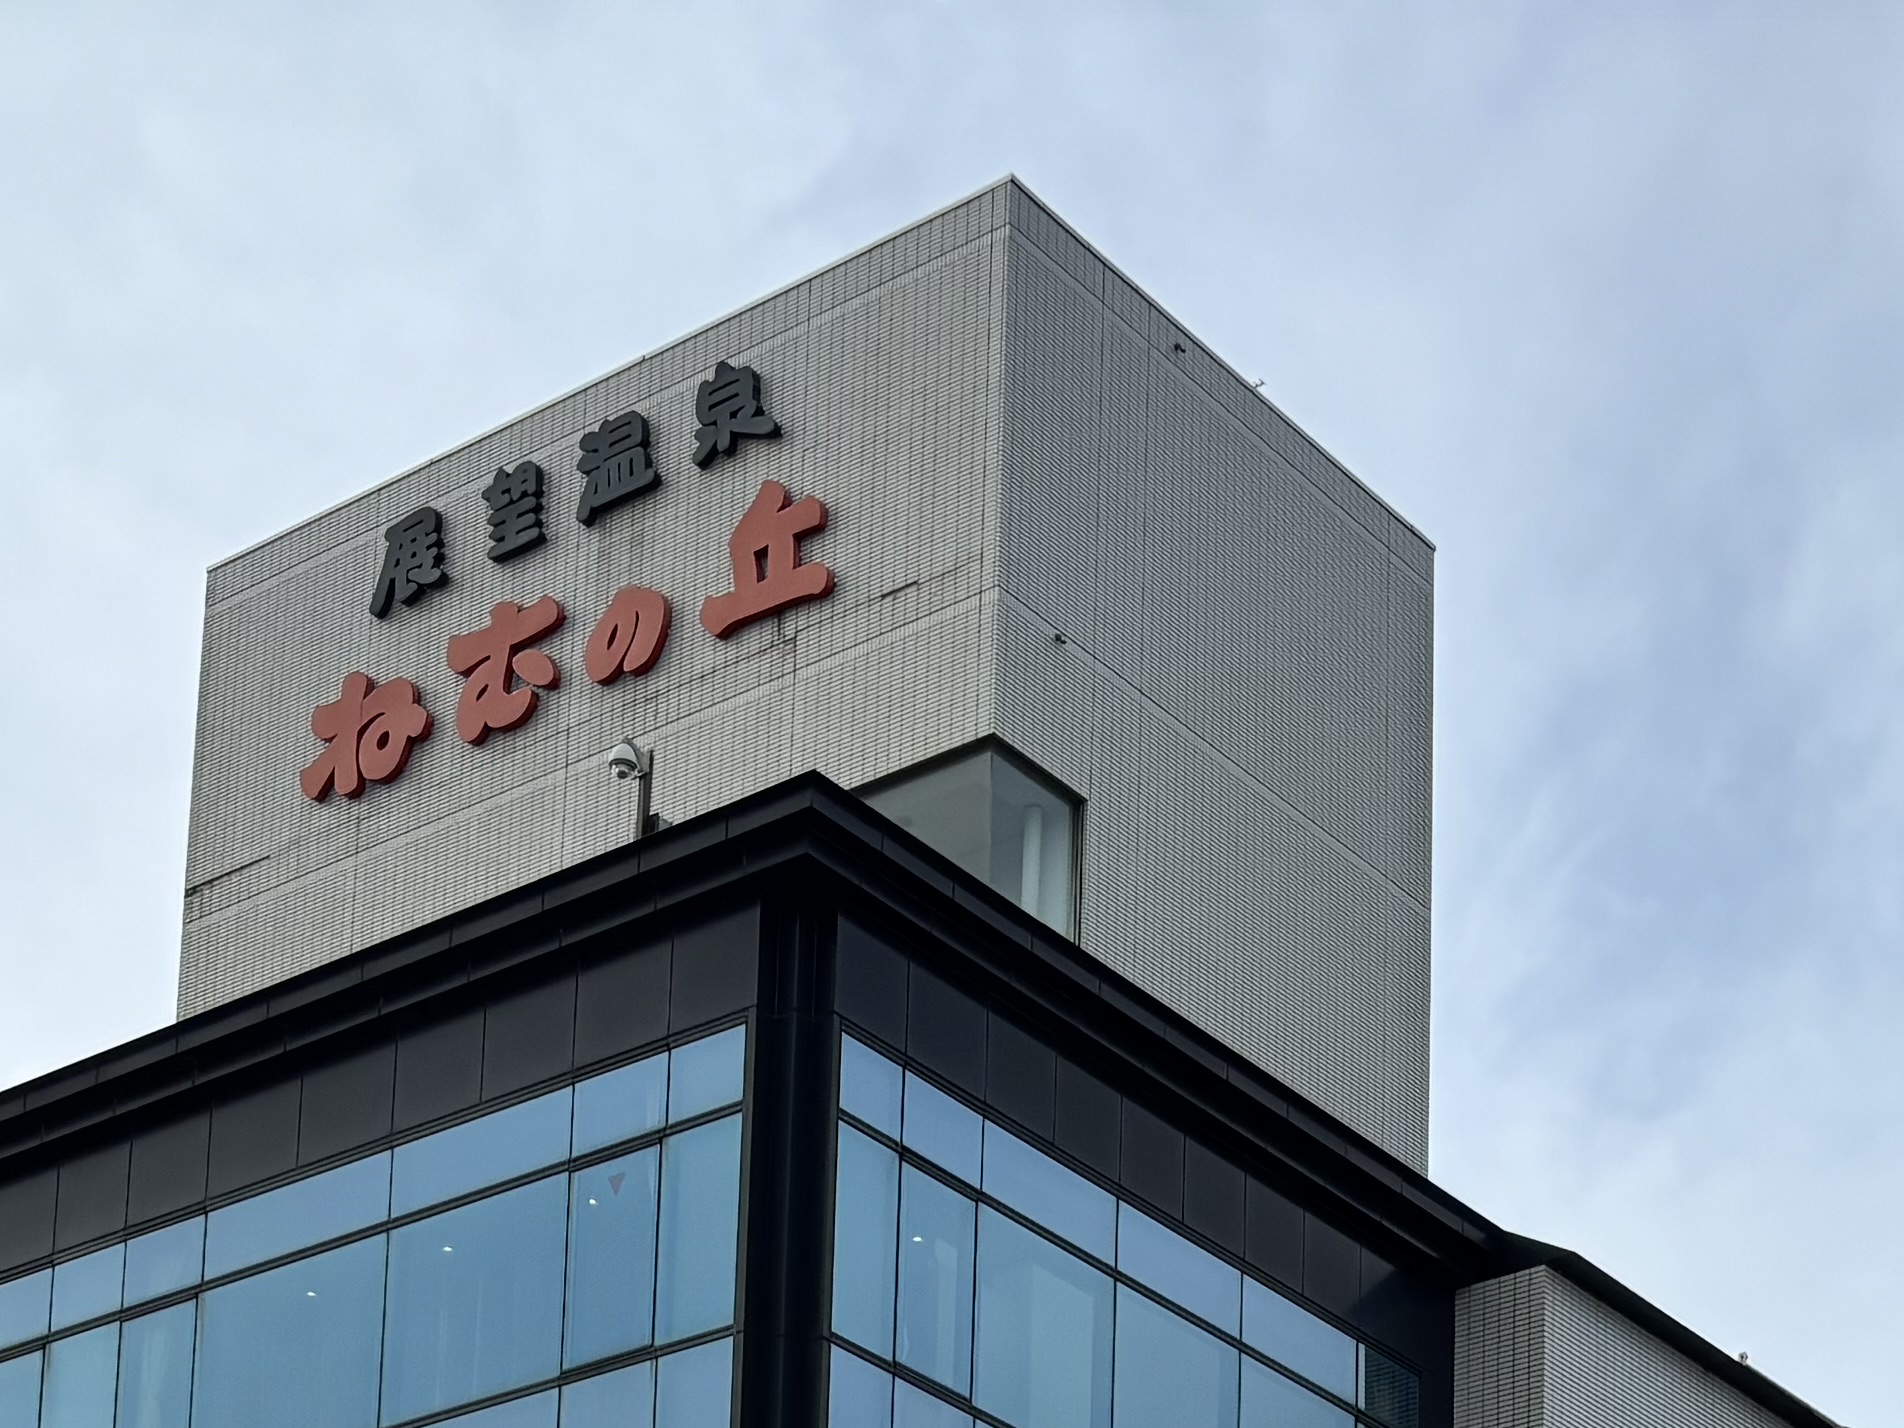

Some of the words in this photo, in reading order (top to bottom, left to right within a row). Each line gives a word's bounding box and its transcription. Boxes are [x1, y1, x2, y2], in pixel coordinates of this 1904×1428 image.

[369, 361, 782, 618] 展望温泉
[299, 478, 837, 801] ねむの丘
